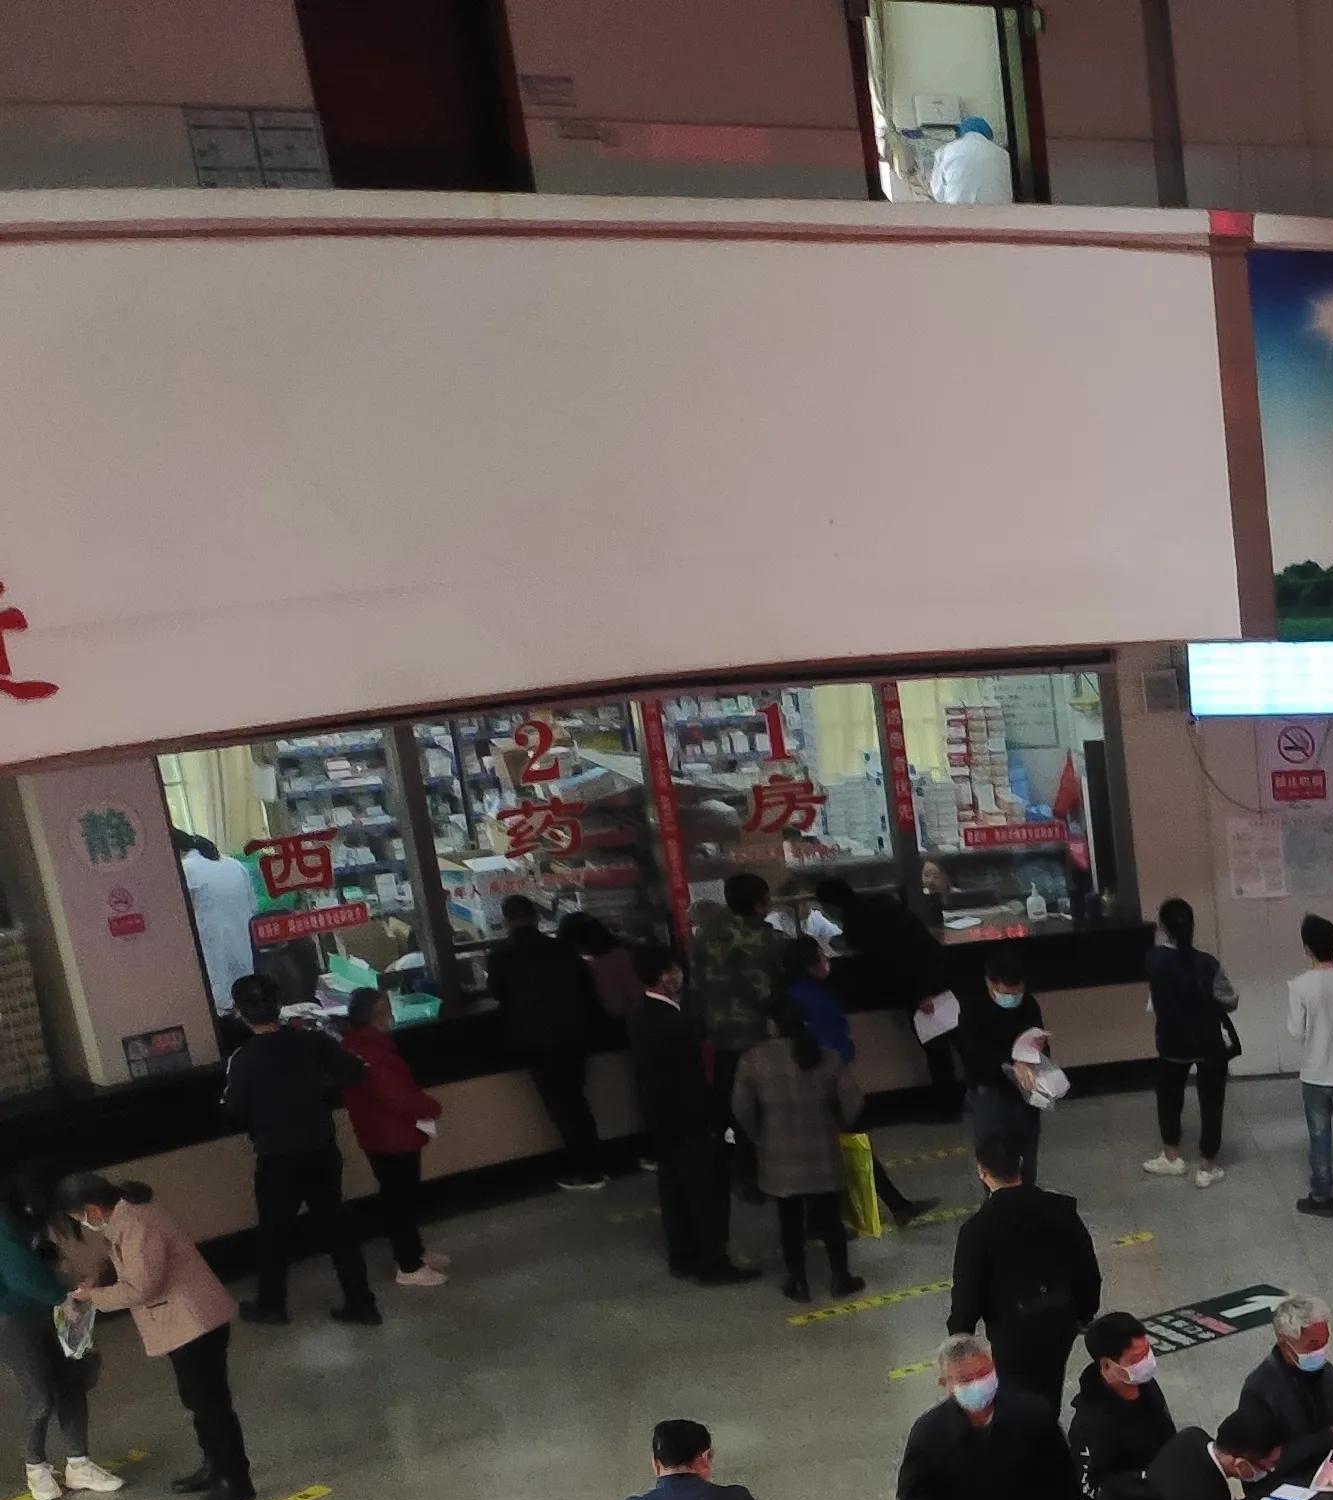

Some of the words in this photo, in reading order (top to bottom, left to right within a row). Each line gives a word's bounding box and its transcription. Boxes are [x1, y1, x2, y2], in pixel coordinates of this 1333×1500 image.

[514, 720, 560, 784] 2
[755, 703, 792, 761] 1
[244, 827, 338, 897] 西
[497, 798, 584, 860] 药
[743, 775, 827, 832] 房
